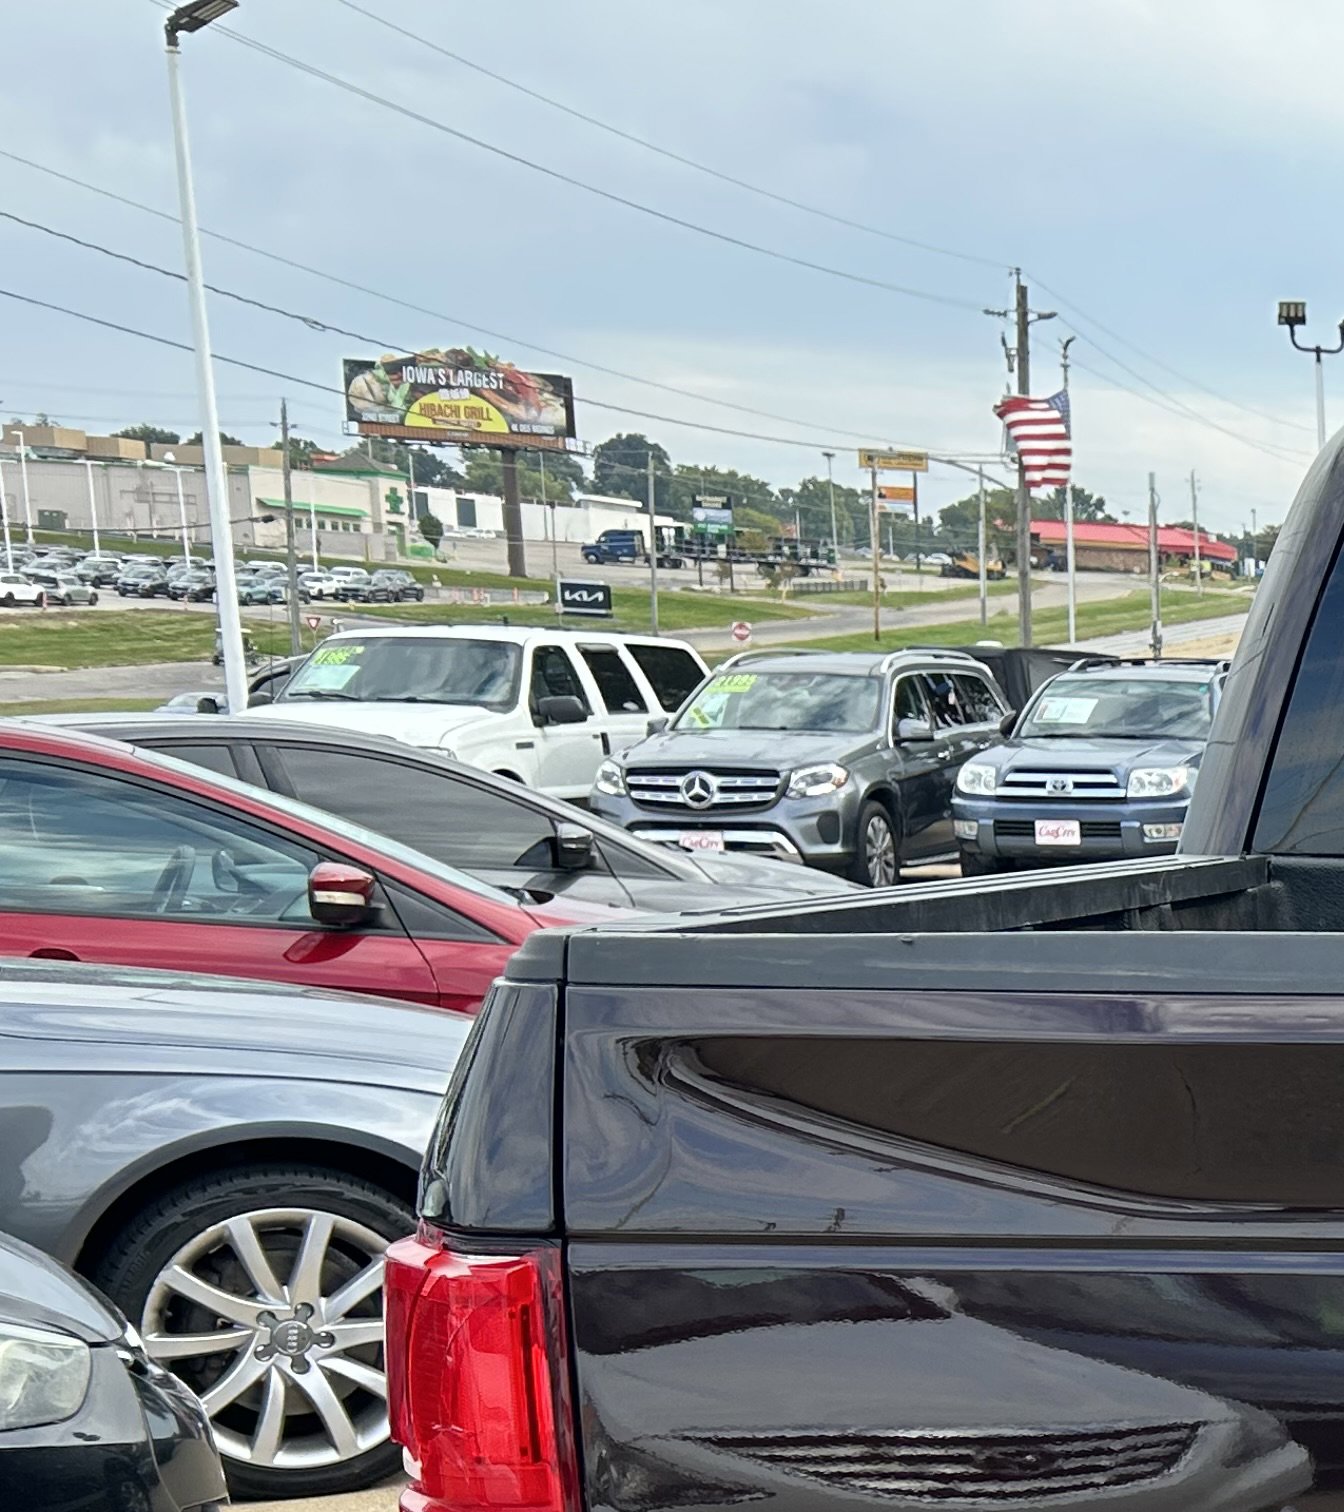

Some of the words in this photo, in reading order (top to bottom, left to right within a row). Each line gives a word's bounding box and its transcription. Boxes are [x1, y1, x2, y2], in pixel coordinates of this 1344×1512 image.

[402, 366, 447, 386] IOWA'S
[449, 369, 505, 390] LARGEST
[419, 402, 461, 418] HIBACHI
[464, 405, 493, 421] GRILL
